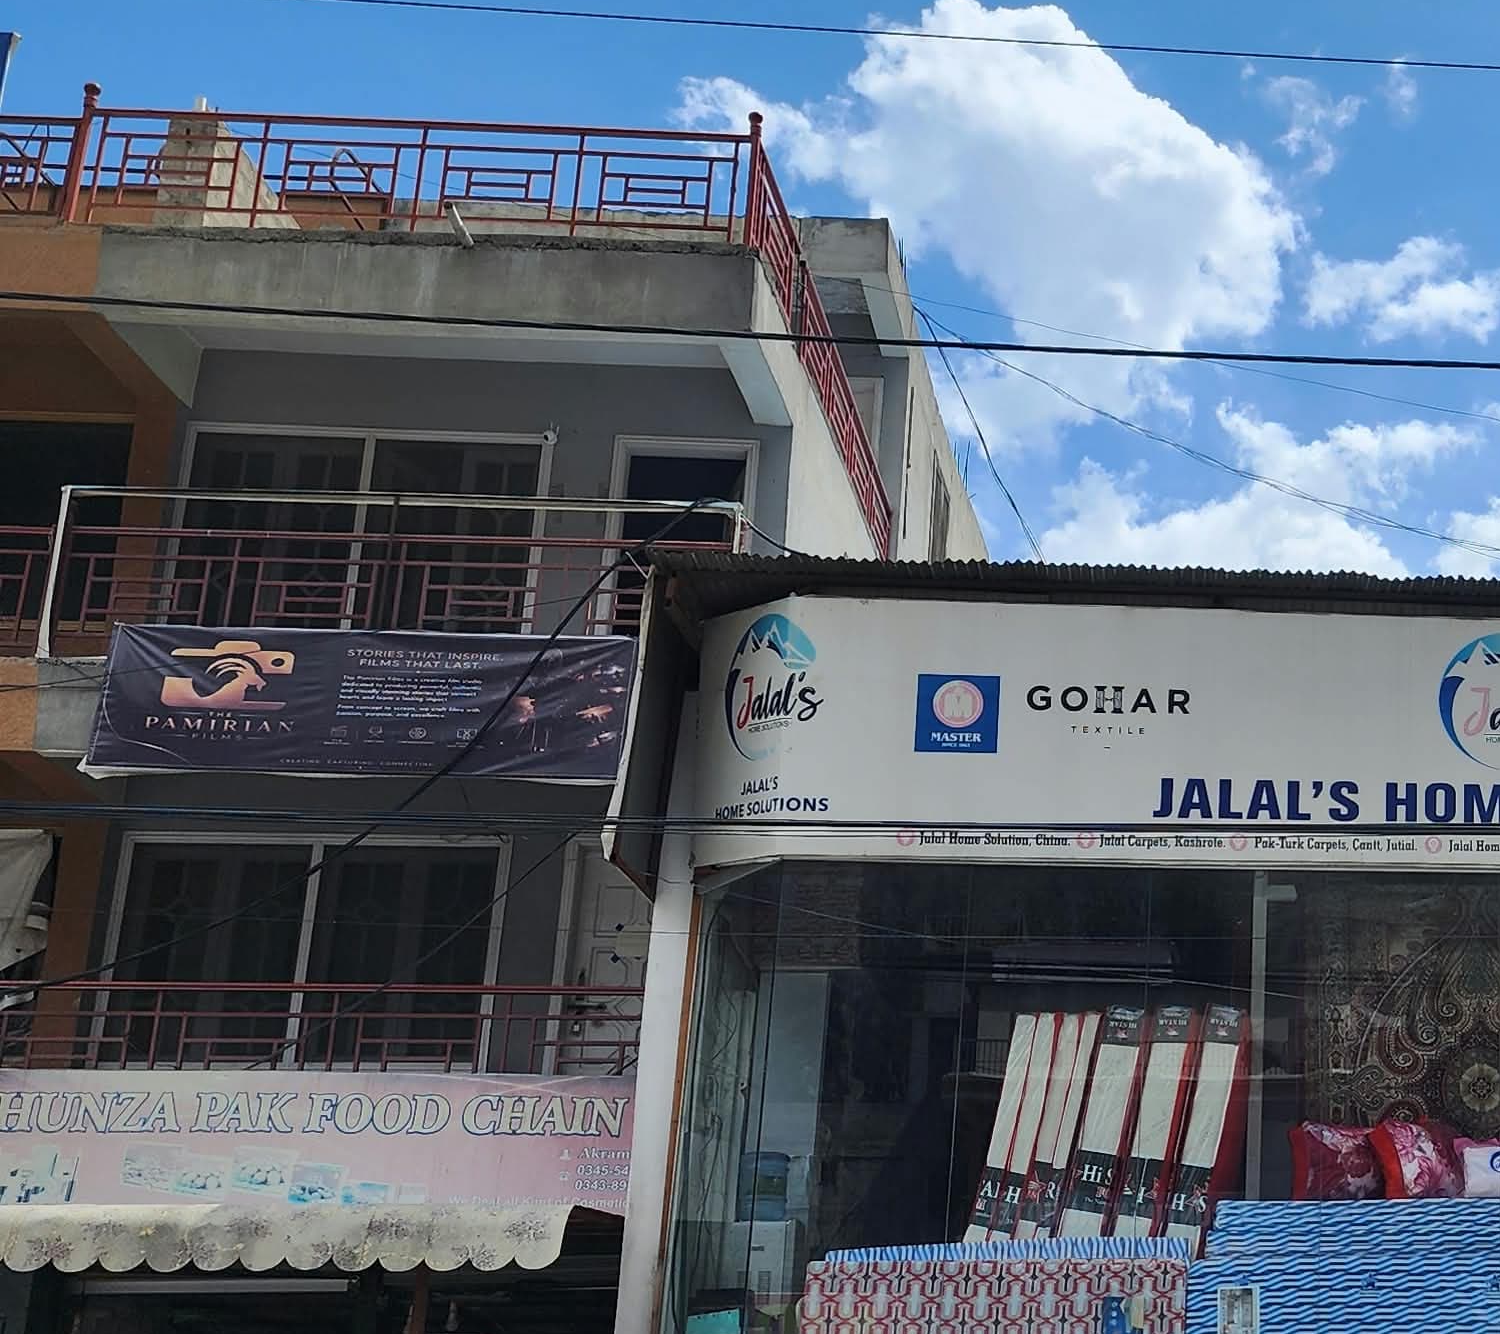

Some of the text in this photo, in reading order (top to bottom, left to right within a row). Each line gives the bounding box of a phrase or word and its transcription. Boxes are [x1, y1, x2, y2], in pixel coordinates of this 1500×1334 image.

[348, 649, 504, 662] STORIES THAT INSPIRE.
[359, 658, 482, 669] FILMS THAT LAST.
[736, 670, 825, 730] Jalal's
[1026, 685, 1191, 715] GOHAR
[144, 715, 296, 733] PAMIRIAN
[1071, 725, 1145, 735] TEXTILE
[930, 732, 982, 743] MASTER
[740, 775, 779, 796] JALAL'S
[1152, 777, 1360, 822] JALAL'S
[715, 797, 829, 819] HOME SOLUTIONS
[1099, 834, 1125, 849] Jalal
[1127, 835, 1171, 850] Carpets,
[1253, 836, 1305, 851] Pak-Turk
[1307, 837, 1350, 853] Carpets,
[1385, 838, 1418, 853] Jutial.
[1448, 839, 1473, 854] Jalal
[0, 1091, 630, 1138] HUNZA PAK FOOD CHAIN
[577, 1147, 631, 1160] Akram
[575, 1164, 629, 1178] 0345-54
[573, 1179, 628, 1192] 0343-89
